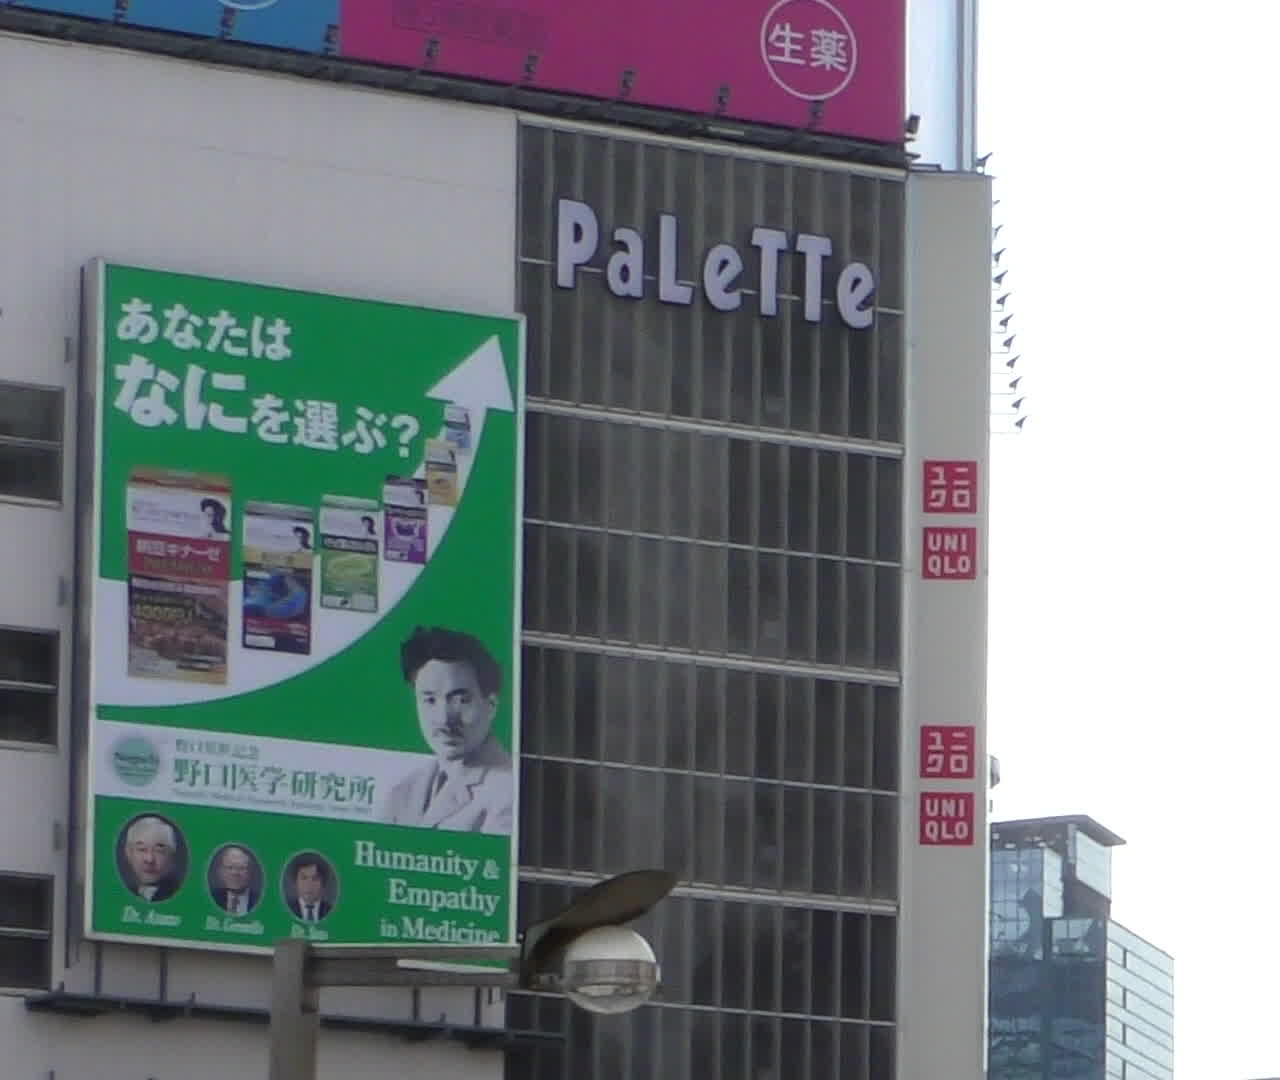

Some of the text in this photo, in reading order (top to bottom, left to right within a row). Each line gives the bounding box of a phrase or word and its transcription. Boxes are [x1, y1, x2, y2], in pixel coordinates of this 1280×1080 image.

[769, 23, 849, 71] 生薬
[115, 297, 292, 361] あなたは
[927, 533, 968, 552] UNI
[928, 555, 971, 577] QLO
[174, 758, 376, 805] 野口医学研究所
[925, 797, 965, 817] UNI
[925, 820, 969, 842] QLO
[354, 840, 500, 880] Humanity &
[387, 877, 501, 917] Empathy
[379, 915, 501, 944] in Medicine
